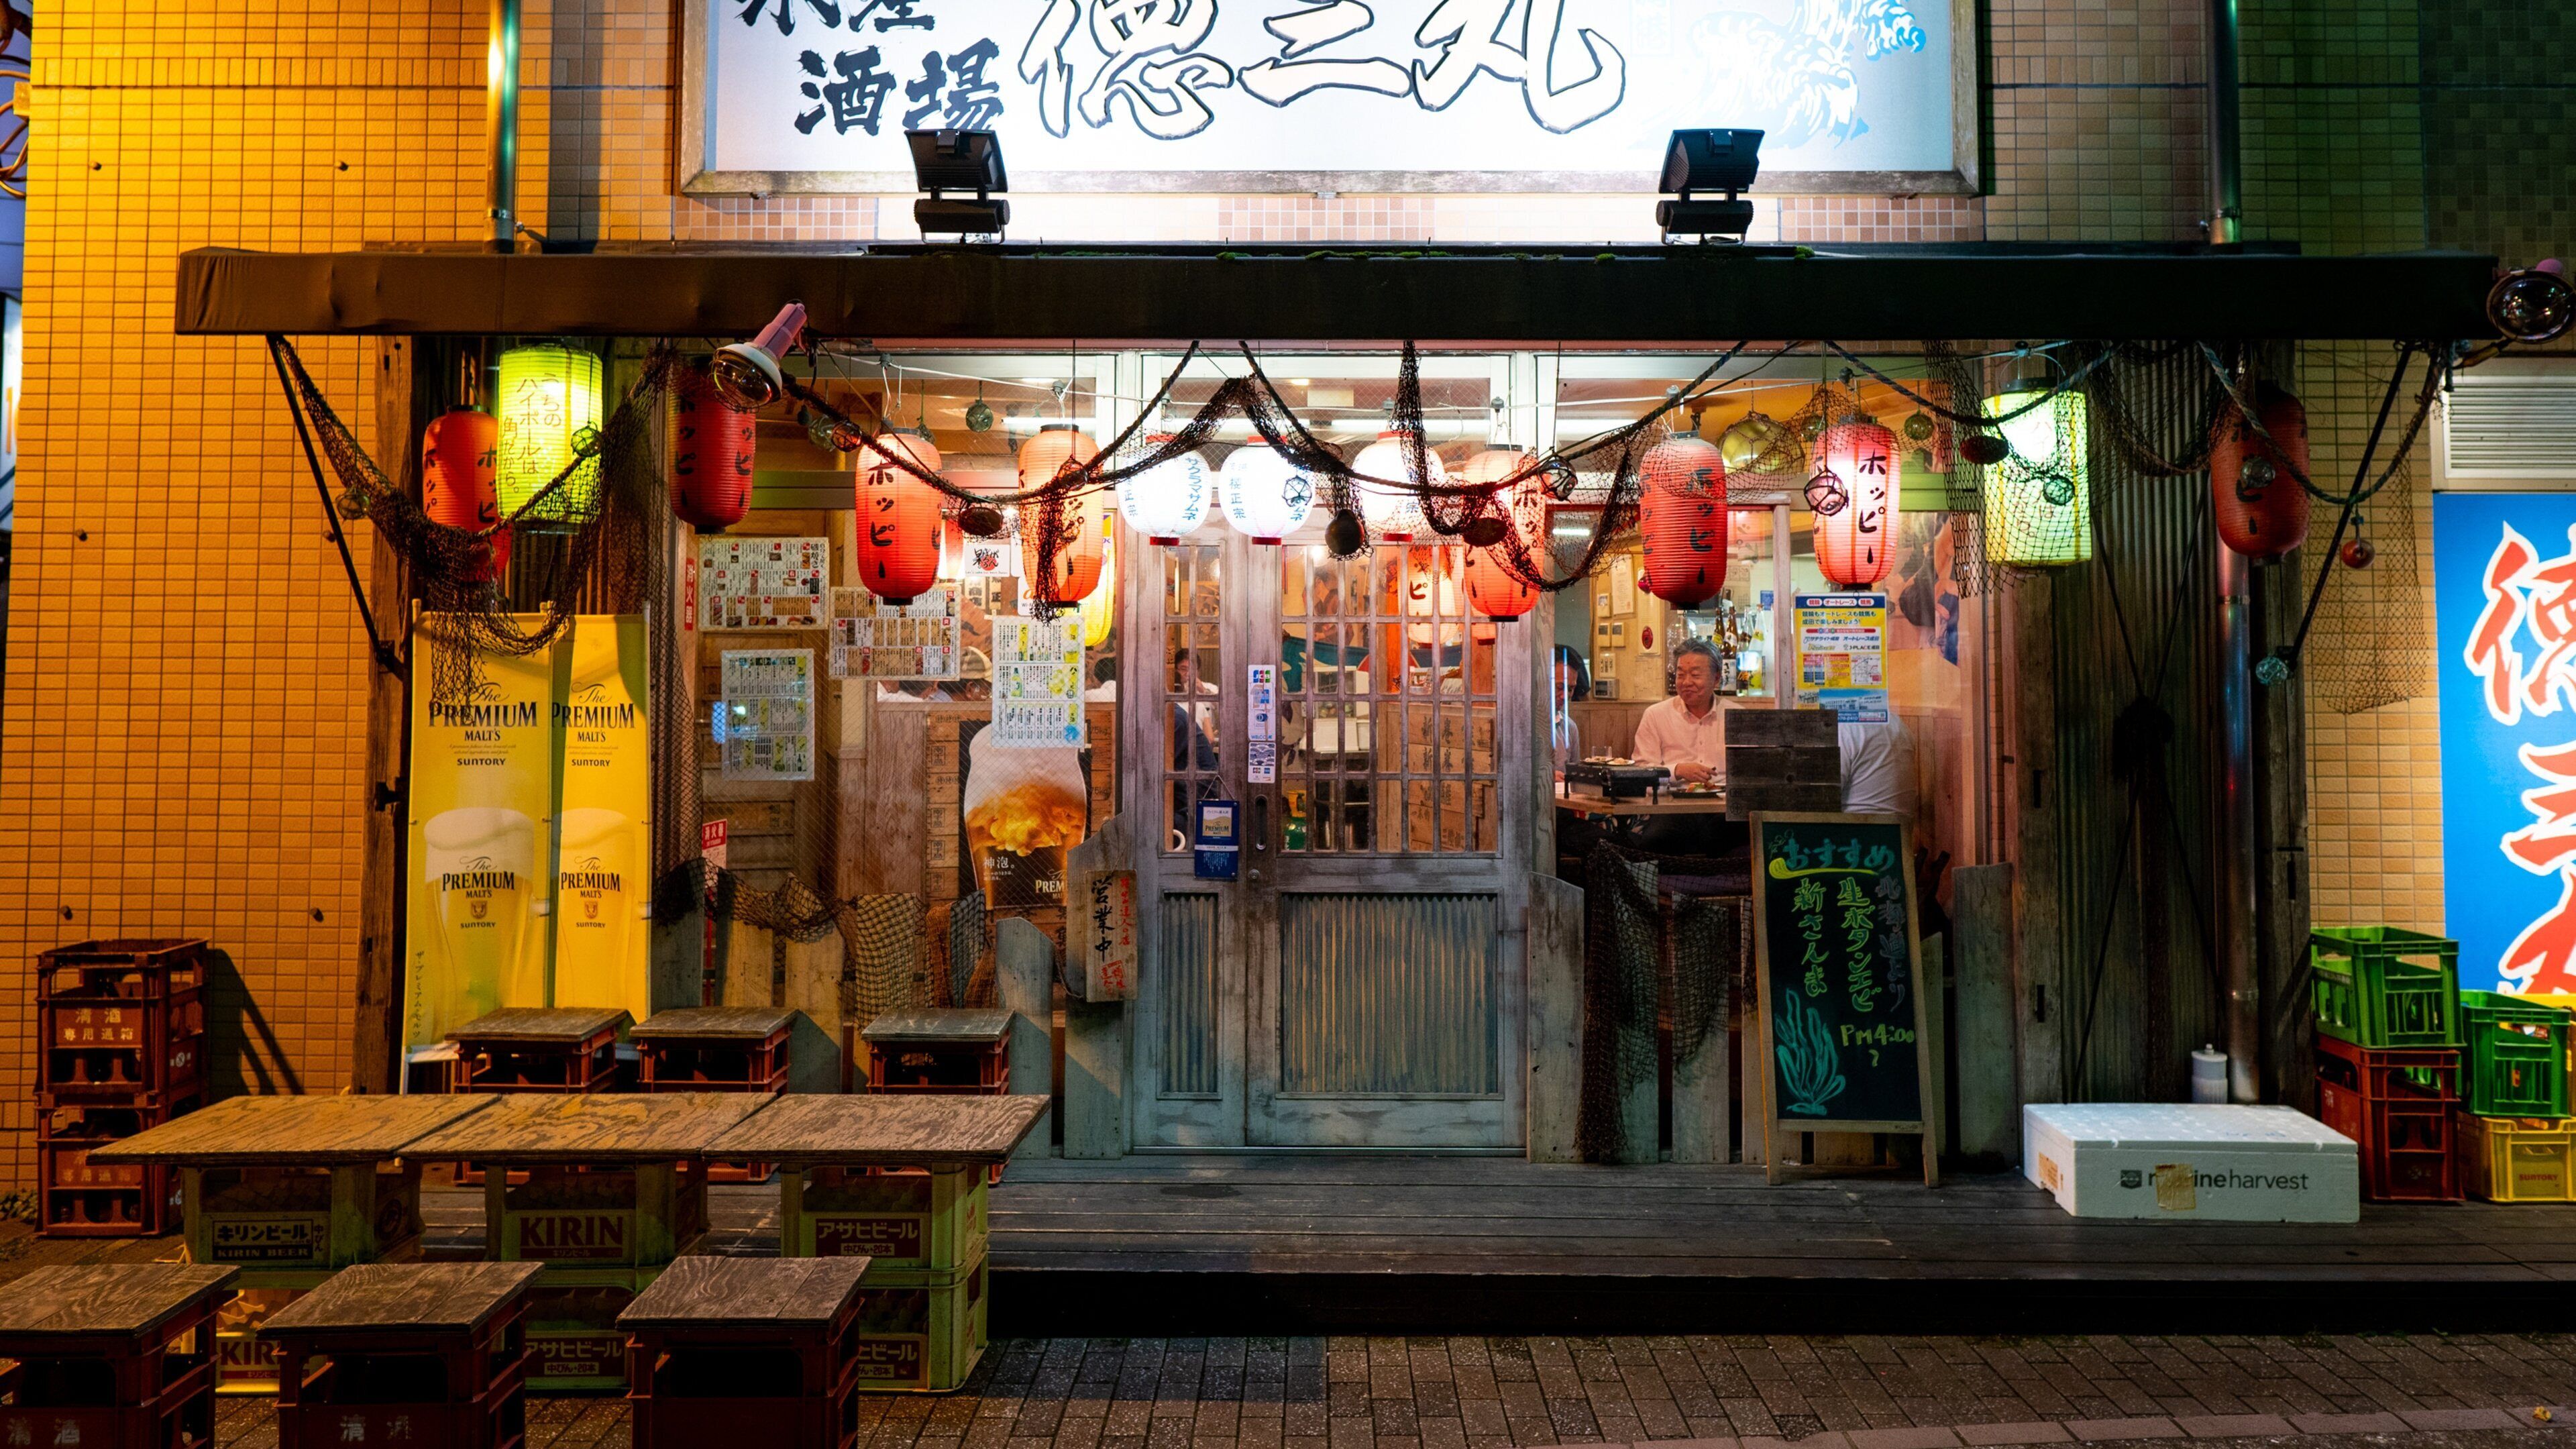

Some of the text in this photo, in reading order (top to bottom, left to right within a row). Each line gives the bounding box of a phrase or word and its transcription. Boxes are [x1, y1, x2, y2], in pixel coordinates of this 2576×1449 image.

[794, 38, 1004, 136] 酒場
[517, 378, 541, 474] ハイボールは
[1859, 448, 1888, 564] ホッピー
[867, 460, 896, 578] ホッピー
[1686, 467, 1715, 584] ホッピー
[1253, 670, 1271, 683] JCB
[571, 682, 612, 703] The
[429, 701, 538, 727] PREMIUM
[551, 703, 636, 729] PREMIUM
[464, 729, 501, 741] MALT'S
[577, 731, 606, 743] MALT'S
[457, 758, 506, 766] SUNTORY
[571, 759, 610, 767] SUNTORY
[460, 856, 497, 871] The
[574, 856, 608, 871] The
[983, 856, 1015, 869] 神泡。
[1783, 838, 1896, 870] おすすめ
[442, 871, 515, 892] PREMIUM
[560, 872, 621, 892] PREMIUM
[466, 889, 492, 898] MALT'S
[580, 889, 602, 899] MALT'S
[1091, 875, 1115, 963] 営業中
[1791, 877, 1829, 998] 新さんま
[1837, 876, 1882, 1013] 生ボタンエビ
[1875, 874, 1907, 1012] 北海道より
[217, 1224, 309, 1242] キリンビール
[314, 1224, 324, 1252] 中びん
[520, 1216, 623, 1246] KIRIN
[818, 1222, 918, 1239] アサヒビール
[218, 1248, 309, 1257] KIRIN BEER
[552, 1249, 591, 1257] キリンビール
